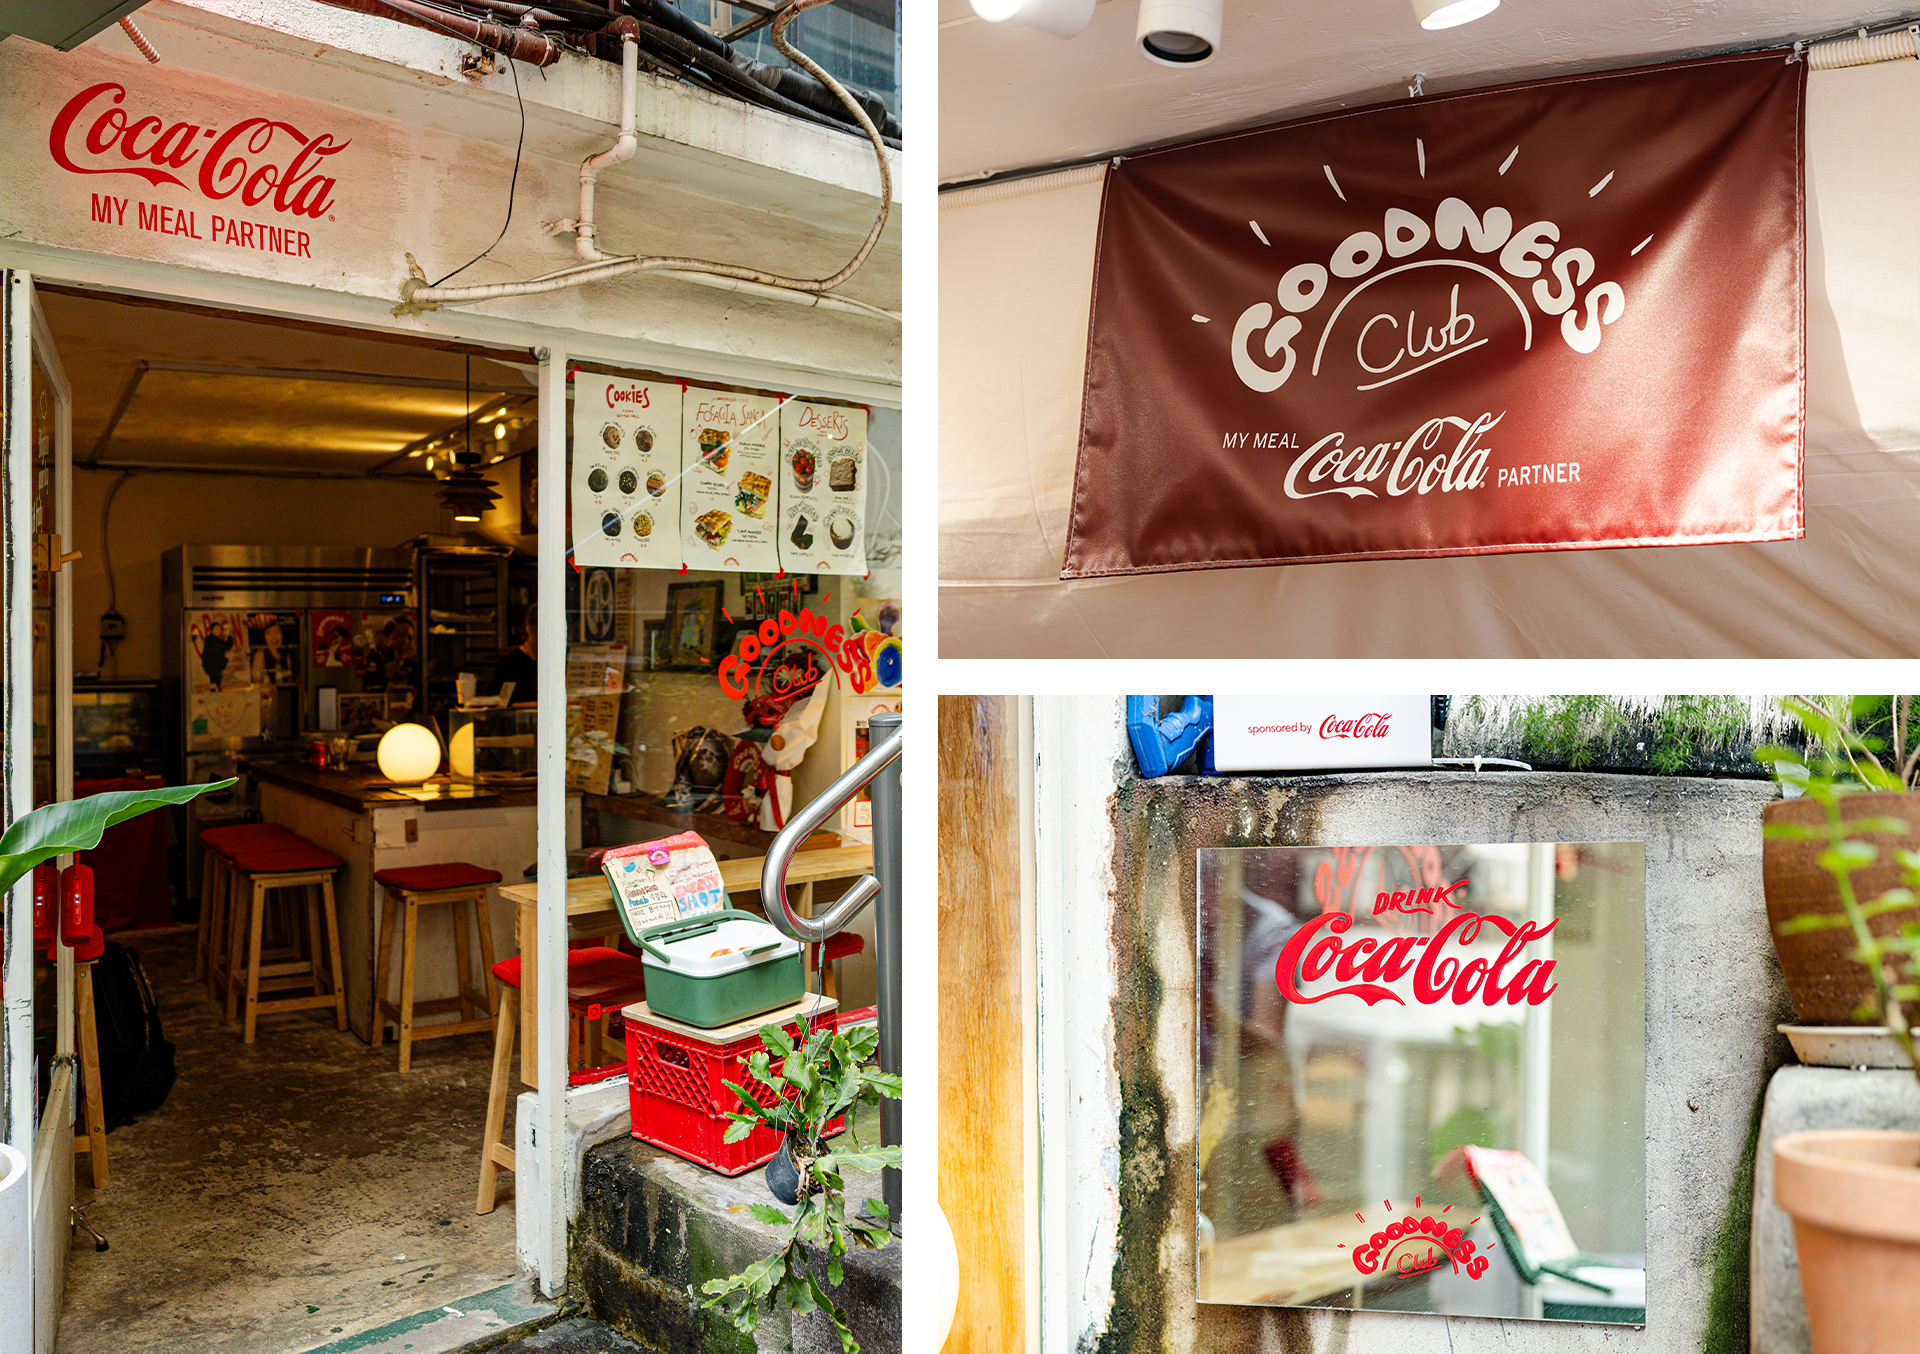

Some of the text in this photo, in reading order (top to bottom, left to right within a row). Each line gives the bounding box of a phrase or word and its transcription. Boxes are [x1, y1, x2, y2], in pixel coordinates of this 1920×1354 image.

[49, 82, 352, 220] Coca-Cola
[91, 193, 311, 259] MY MEAL PARTNER
[1231, 197, 1625, 392] GOODNESS
[1357, 283, 1475, 374] Club
[1222, 409, 1581, 499] MY MEAL Coca-Cola PARTNER
[718, 608, 872, 701] GOODNESS
[773, 652, 818, 694] Club
[1248, 712, 1393, 740] sponsored by Coca-Cola
[675, 873, 719, 899] ENERGY
[677, 888, 721, 914] SHOT
[1372, 880, 1469, 915] DRINK
[1275, 911, 1560, 1006] Coca-Cola
[1352, 1215, 1489, 1280] GOODNESS
[1396, 1246, 1438, 1274] Club
